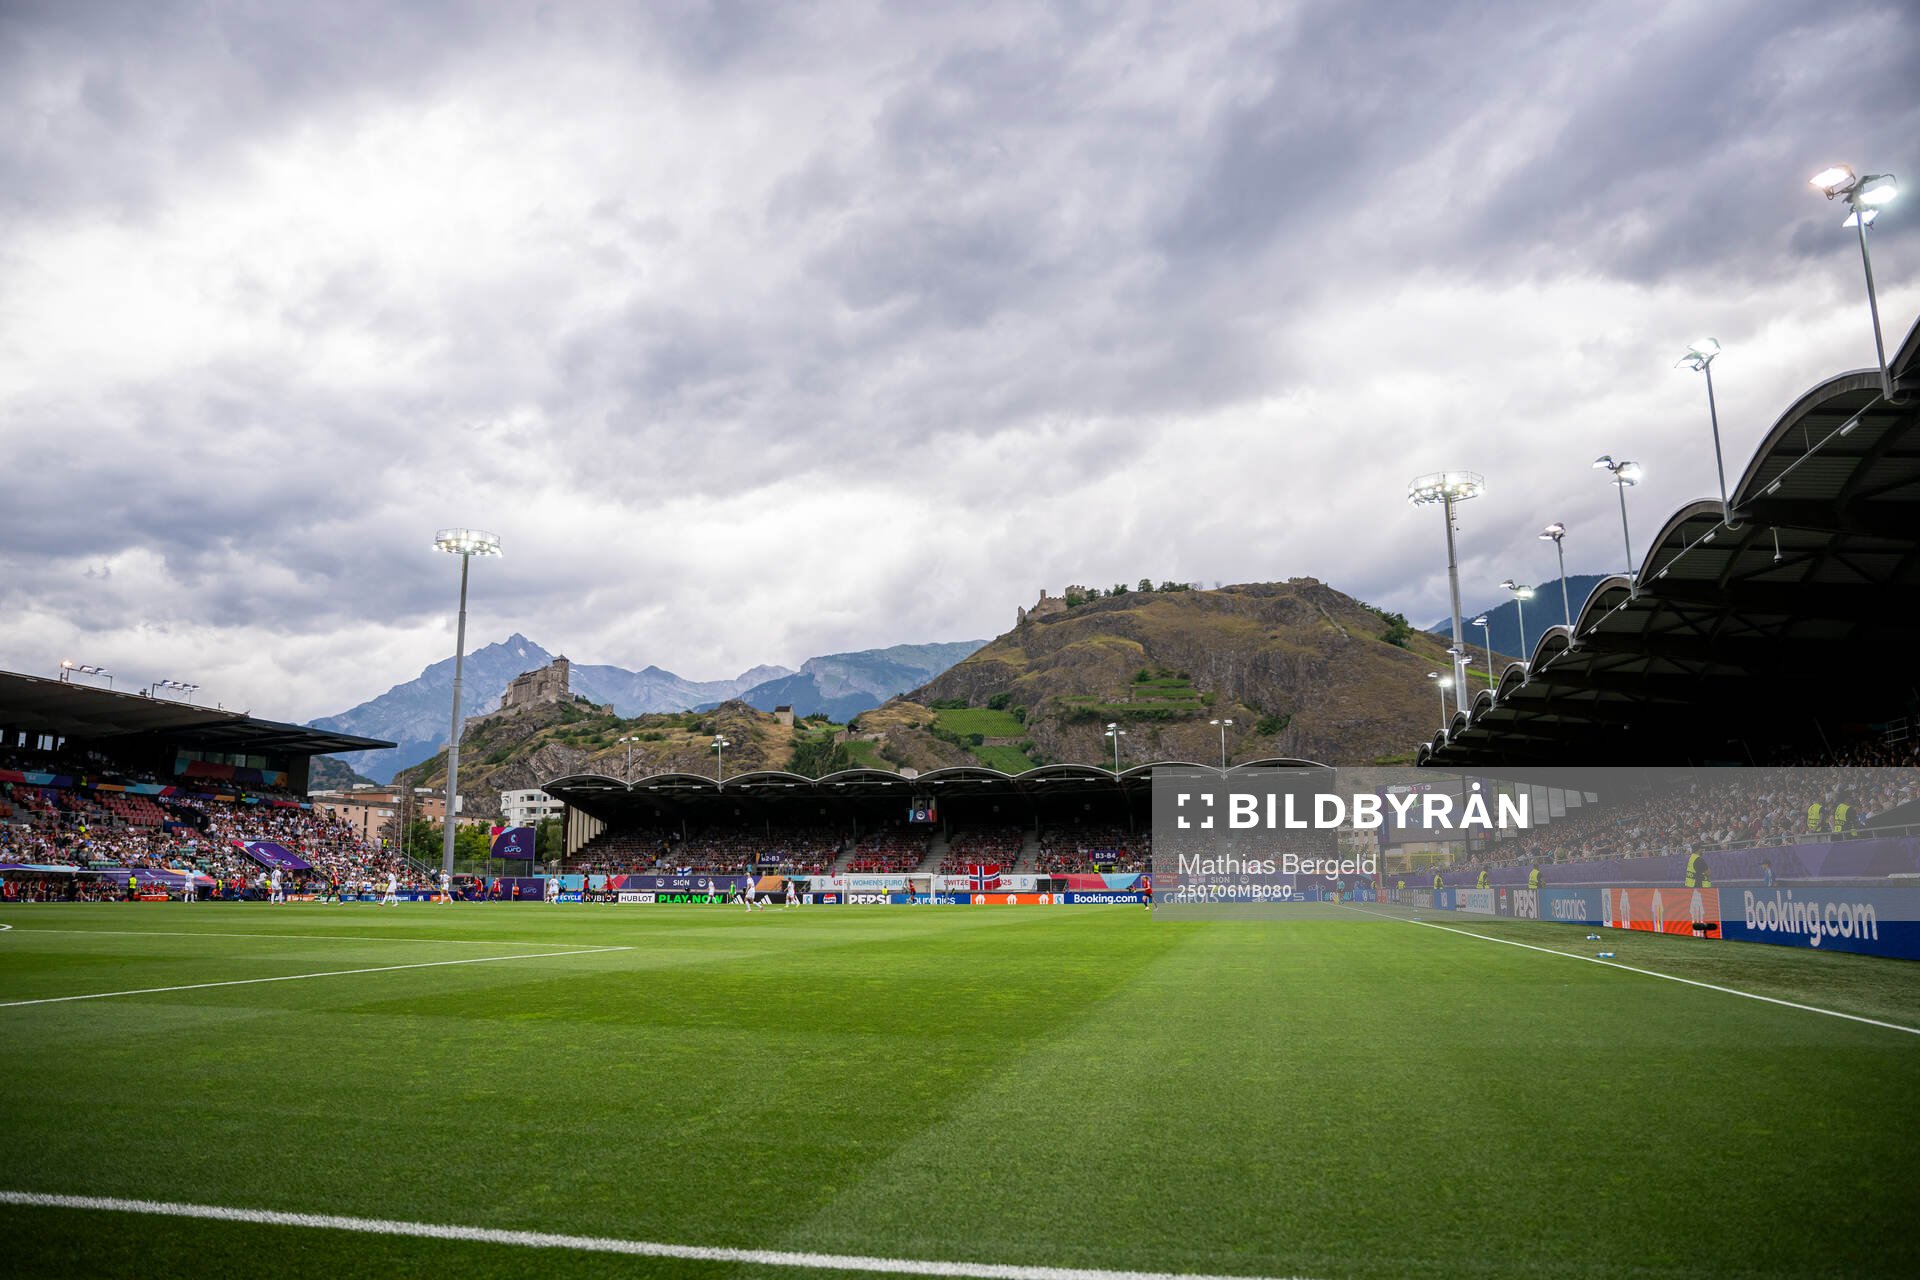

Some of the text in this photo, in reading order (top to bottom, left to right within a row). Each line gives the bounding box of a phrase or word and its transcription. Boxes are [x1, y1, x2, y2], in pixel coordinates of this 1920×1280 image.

[1210, 876, 1230, 884] SION
[658, 894, 724, 904] PLAY NOW
[849, 894, 891, 905] PEPSI
[1073, 893, 1138, 905] Booking.com
[1513, 889, 1538, 919] PEPSI
[1555, 891, 1587, 920] euronics
[1743, 889, 1879, 947] Booking.com
